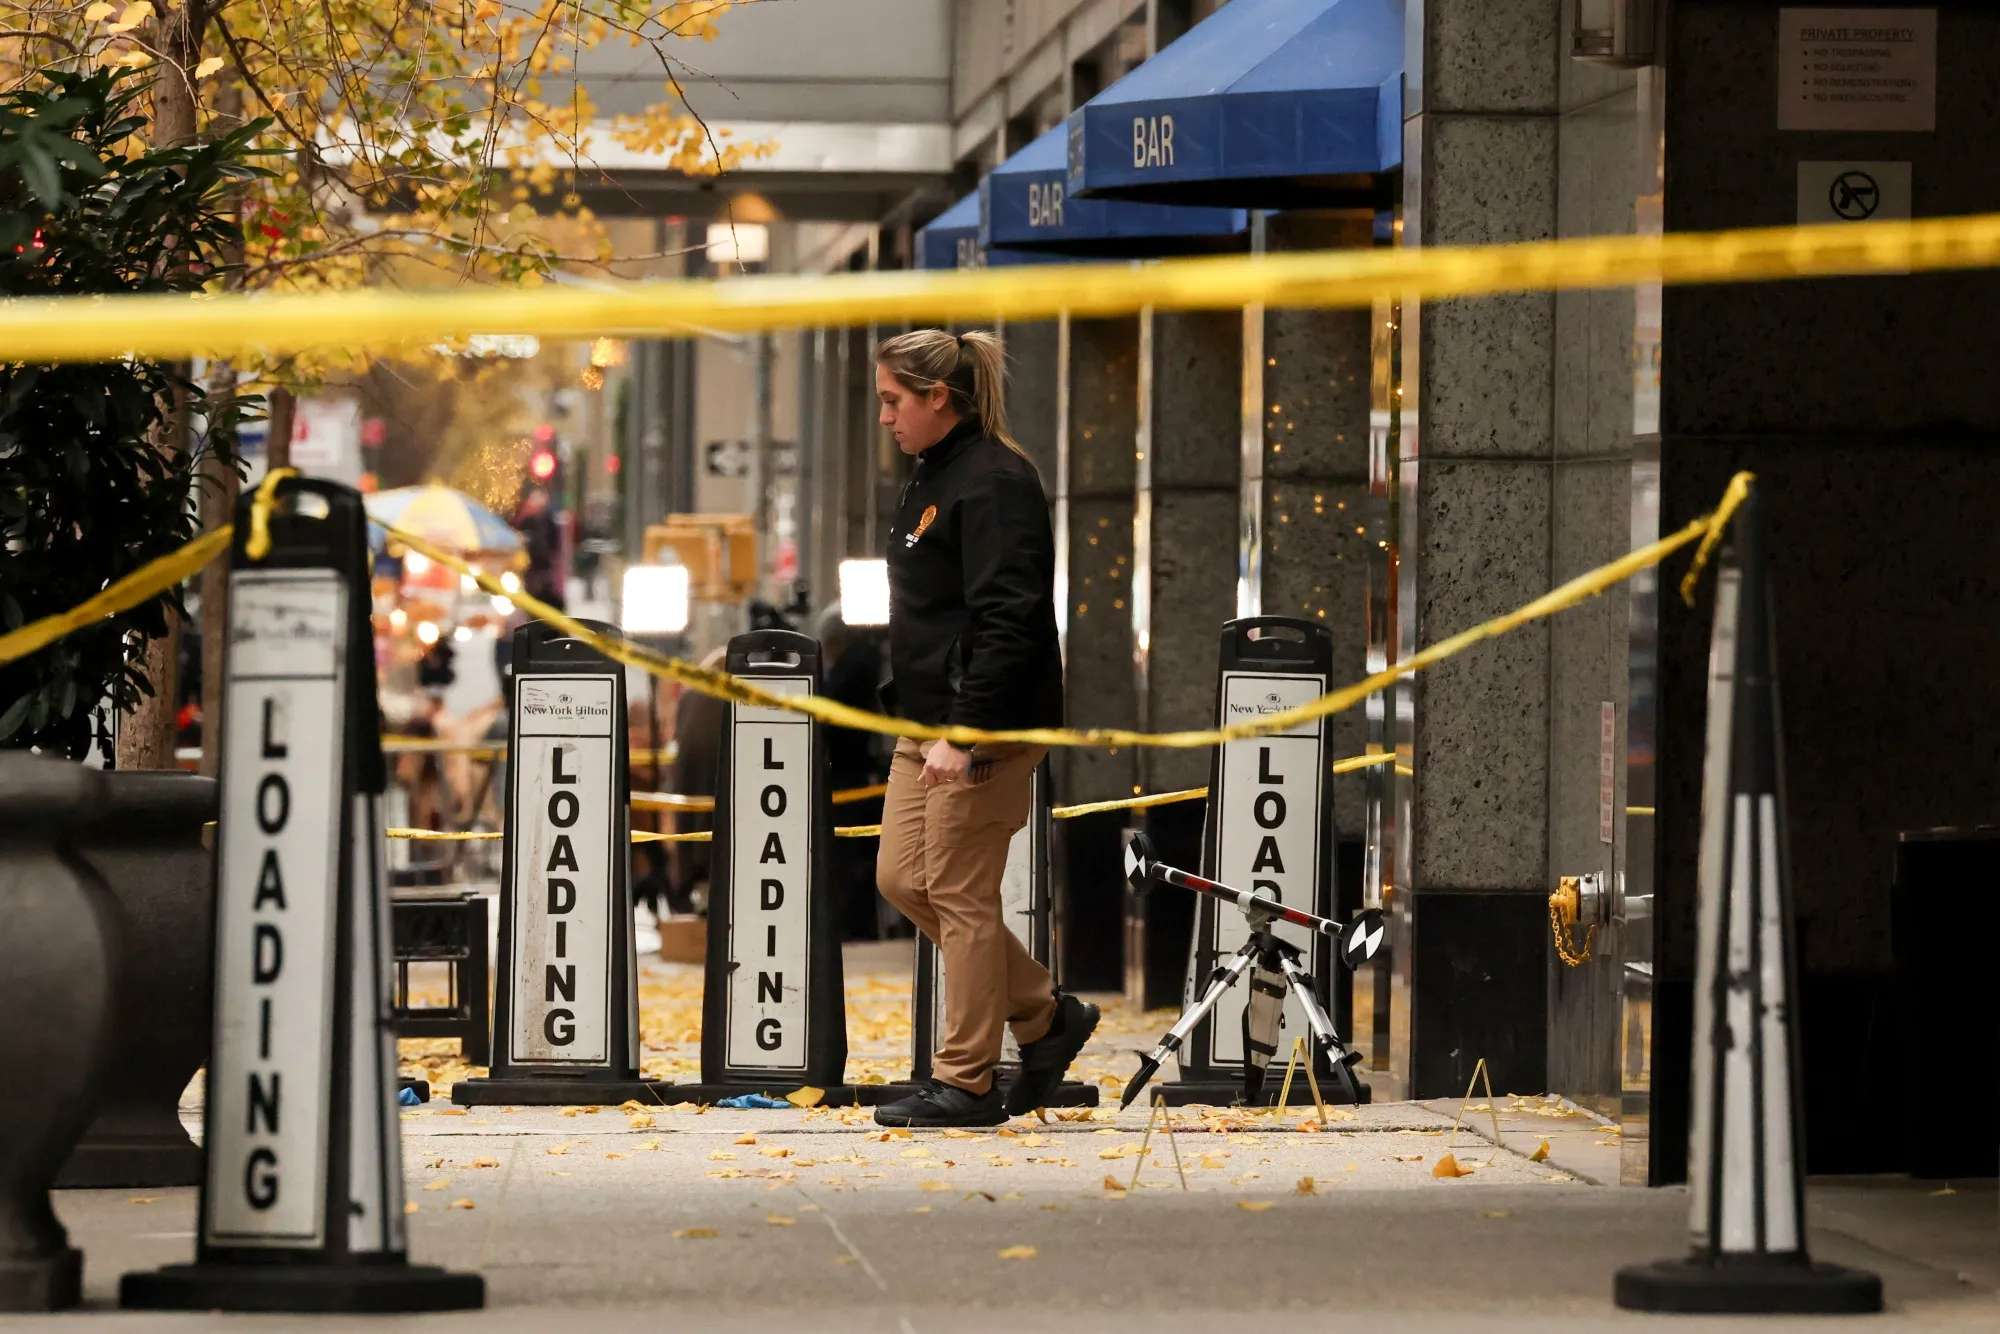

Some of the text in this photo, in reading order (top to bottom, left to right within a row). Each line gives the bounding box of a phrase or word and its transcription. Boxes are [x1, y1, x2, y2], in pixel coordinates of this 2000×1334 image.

[1801, 28, 1914, 41] PRIVATE PROPERTY
[1814, 48, 1891, 58] NO TRESPASSING
[1813, 62, 1828, 72] NO
[1813, 78, 1828, 87] NO
[1813, 92, 1828, 102] NO
[1132, 115, 1174, 168] BAR
[1029, 181, 1064, 227] BAR
[523, 705, 608, 716] New York Hilton
[1230, 703, 1255, 714] New
[543, 747, 580, 1046] LOADING
[755, 737, 788, 1051] LOADING
[243, 698, 292, 1212] LOADING
